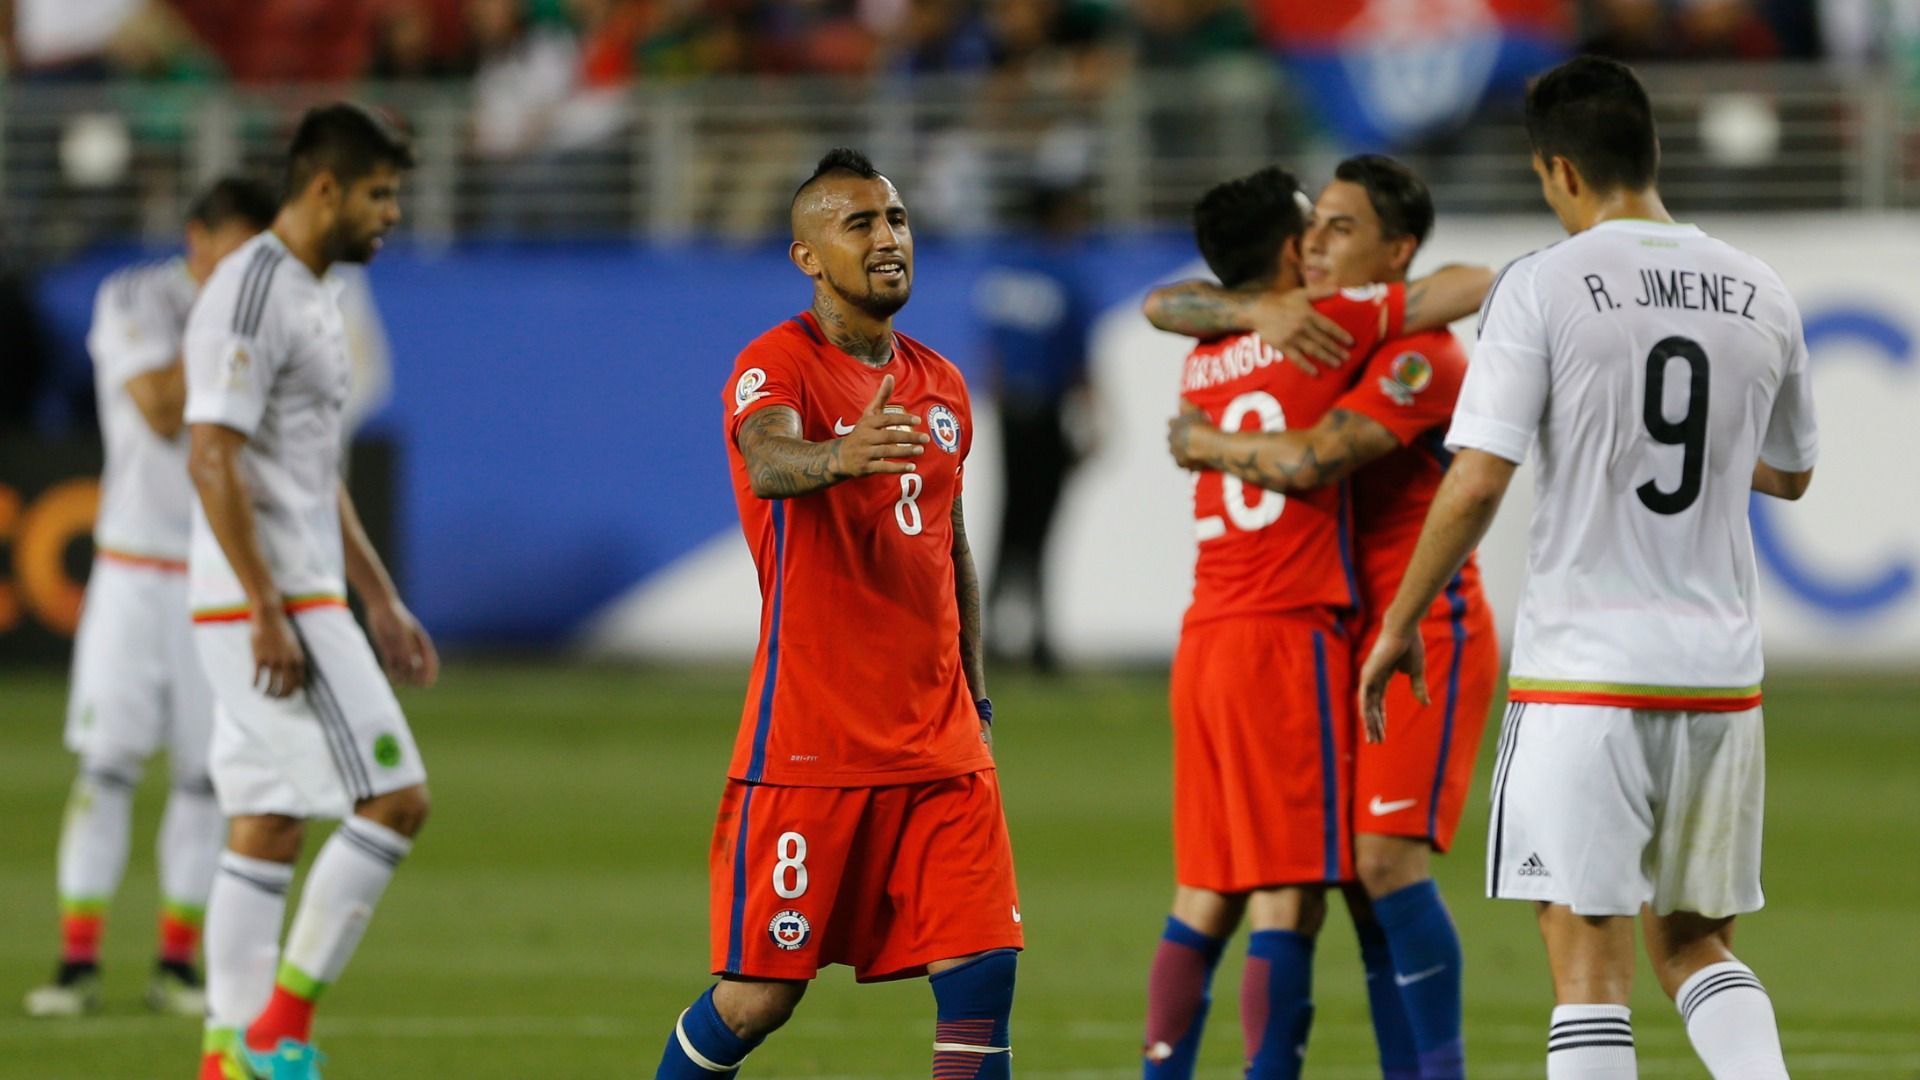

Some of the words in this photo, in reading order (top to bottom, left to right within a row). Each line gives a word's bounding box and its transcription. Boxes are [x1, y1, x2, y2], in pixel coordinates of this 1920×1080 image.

[1584, 273, 1623, 313] R.
[1635, 268, 1757, 321] JIMENEZ
[1635, 335, 1711, 516] 9
[894, 472, 924, 536] 8
[772, 831, 809, 900] 8
